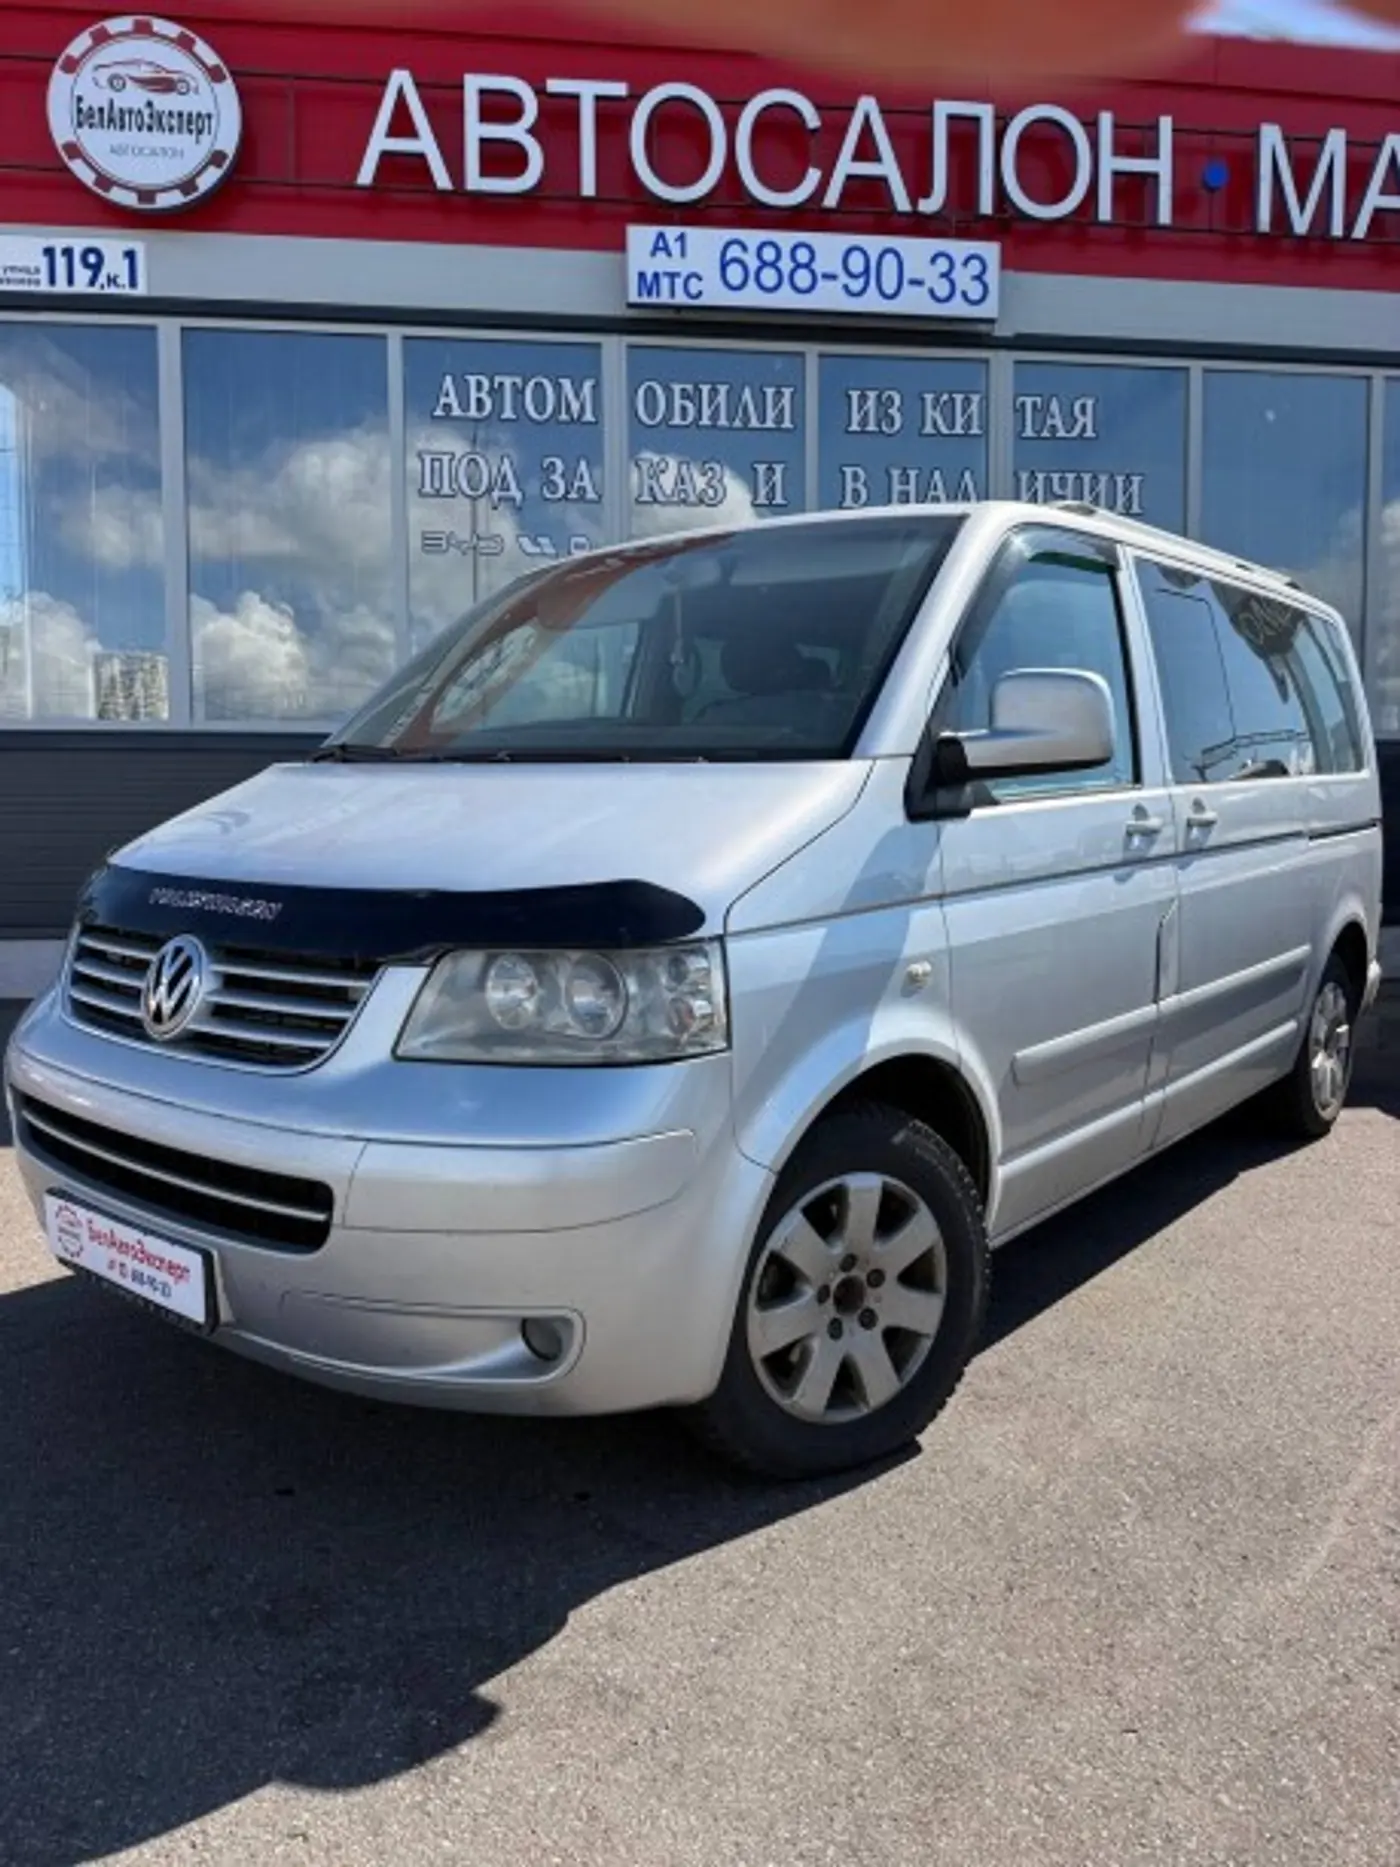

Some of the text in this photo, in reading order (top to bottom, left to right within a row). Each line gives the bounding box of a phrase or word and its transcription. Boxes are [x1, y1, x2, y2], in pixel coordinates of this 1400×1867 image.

[75, 95, 214, 144] БелАвтоЭксперт
[355, 69, 1173, 225] АВТОСАЛОН
[650, 231, 687, 258] A1
[637, 271, 703, 300] МТС
[719, 237, 990, 306] 688-90-33
[847, 390, 902, 433] ИЗ
[418, 452, 523, 508] ПОД
[753, 463, 789, 504] И
[841, 466, 869, 507] В
